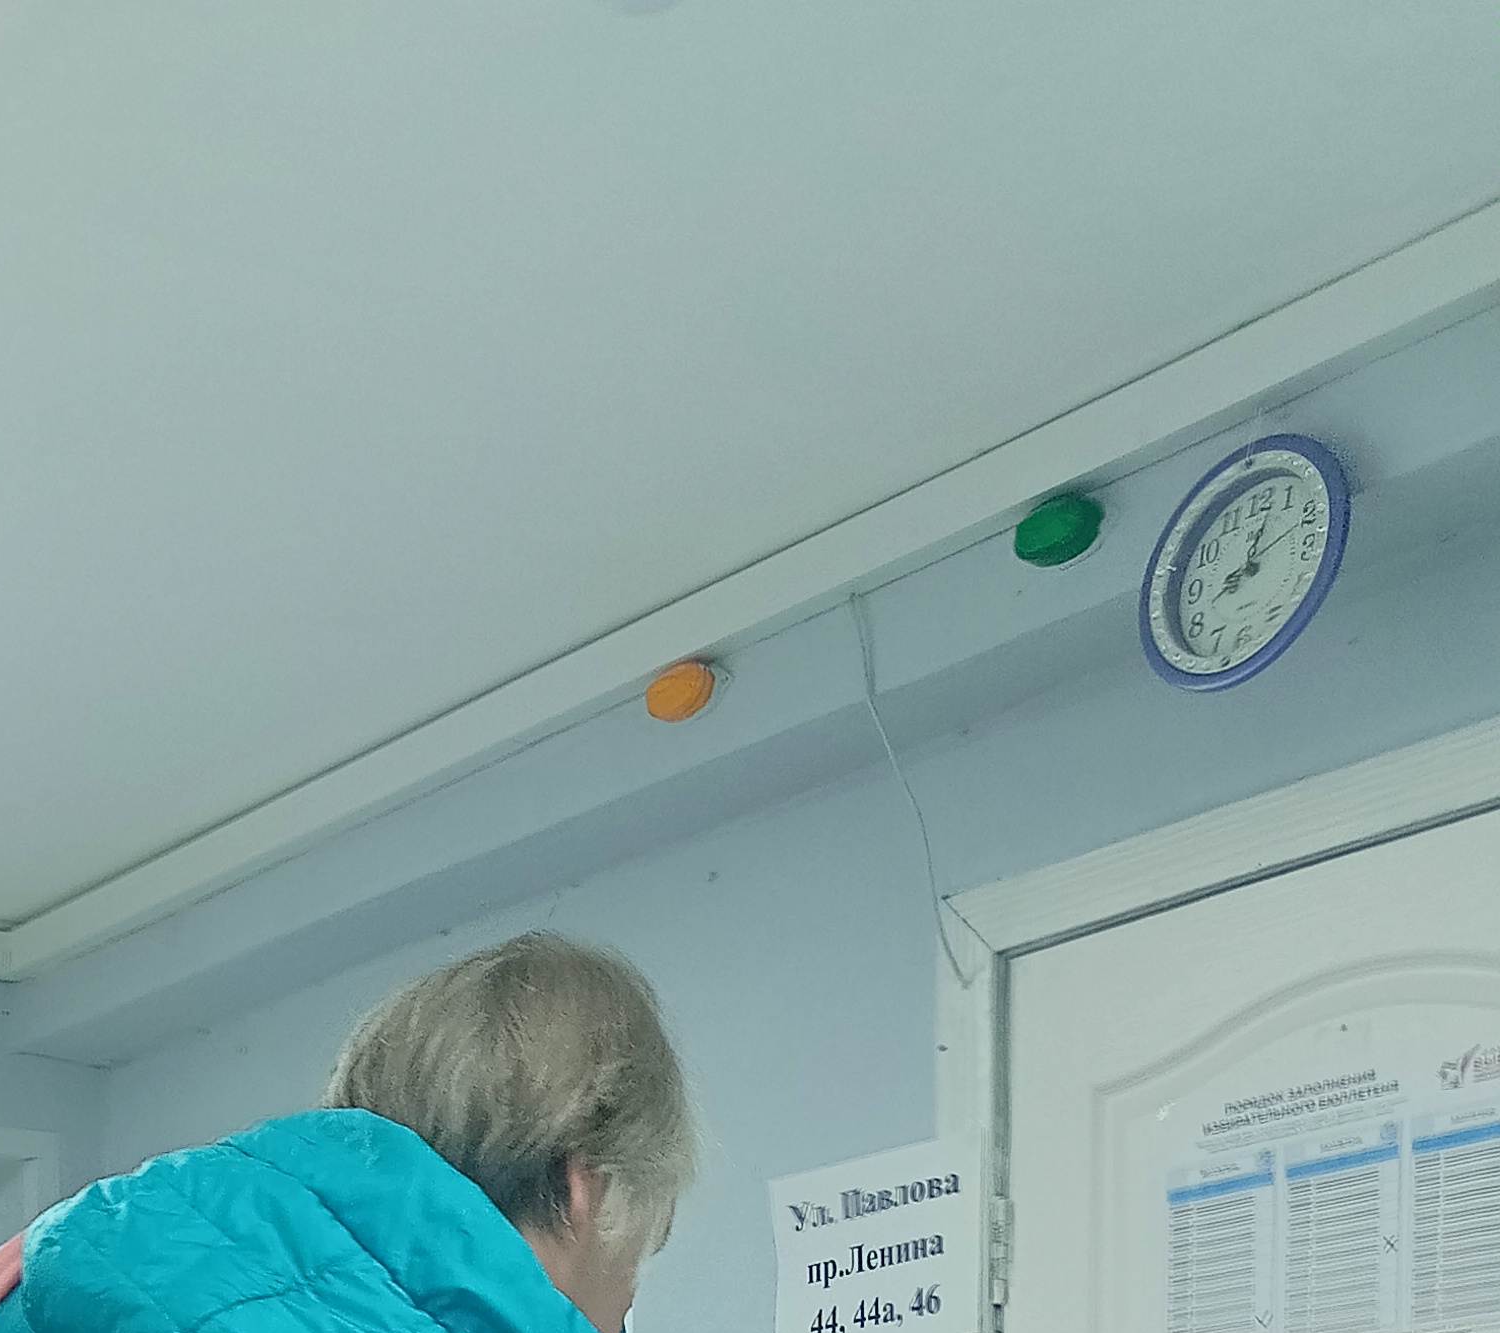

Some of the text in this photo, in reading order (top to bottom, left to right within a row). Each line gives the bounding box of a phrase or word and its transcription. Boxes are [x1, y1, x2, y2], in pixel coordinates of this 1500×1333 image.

[1246, 487, 1275, 519] 12
[1280, 485, 1295, 511] 1
[1219, 506, 1244, 538] 11
[1301, 499, 1316, 528] 2
[1196, 539, 1221, 569] 10
[1187, 578, 1204, 604] 9
[1188, 612, 1205, 638] 8
[1210, 624, 1227, 654] 7
[787, 1172, 960, 1231] Ул. Павлова
[807, 1234, 944, 1289] пр.Ленина
[853, 1296, 904, 1327] 44а,
[909, 1283, 943, 1317] 46
